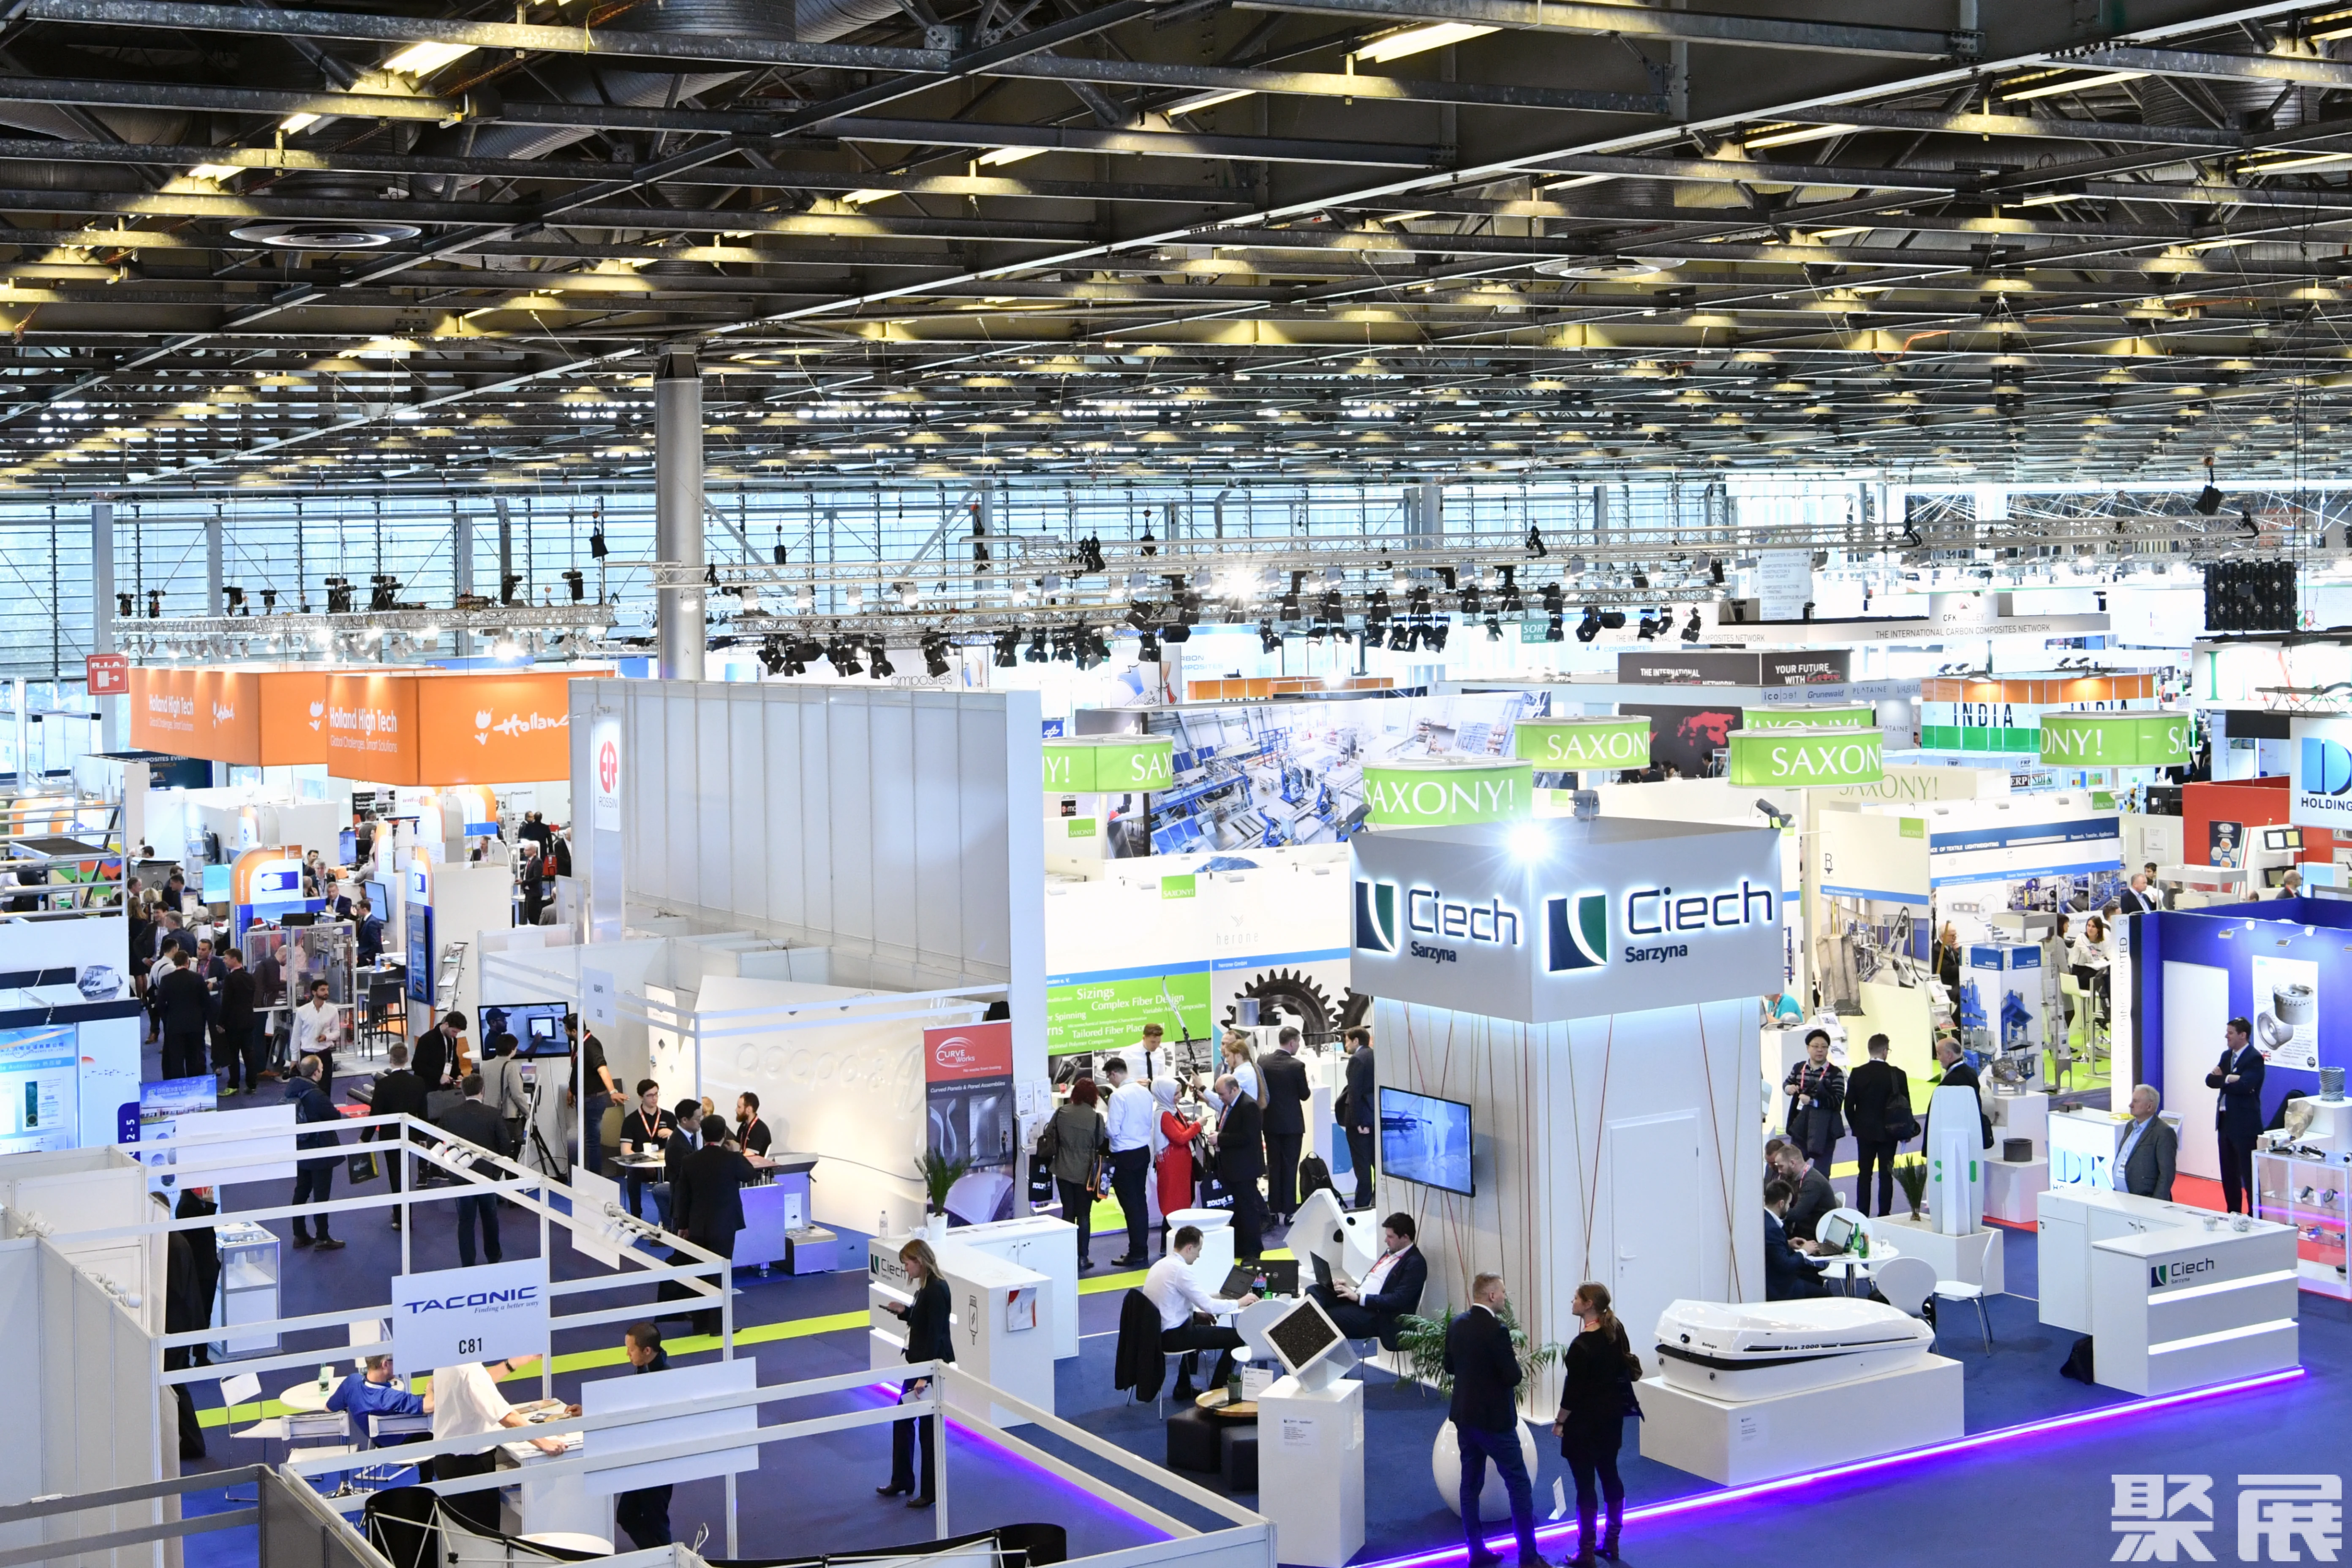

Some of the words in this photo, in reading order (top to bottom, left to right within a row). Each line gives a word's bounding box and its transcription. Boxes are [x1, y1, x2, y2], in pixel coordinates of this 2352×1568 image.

[1876, 631, 1889, 639] THE
[1890, 628, 1944, 638] INTERNATIONAL
[1946, 627, 1974, 635] CARBON
[1975, 625, 2017, 634] COMPOSITES
[2018, 624, 2050, 632] NETWORK
[1775, 665, 1797, 674] YOUR
[1798, 663, 1829, 673] FUTURE
[1785, 675, 1805, 684] WITH
[1808, 689, 1844, 699] Grunewald
[1853, 686, 1887, 694] PLATAINE
[149, 694, 168, 713] Holland
[169, 696, 180, 718] High
[181, 697, 194, 715] Tech
[329, 707, 357, 729] Holland
[359, 708, 376, 736] High
[377, 709, 397, 732] Tech
[1954, 702, 2013, 727] INDIA
[1547, 731, 1650, 761] SAXON
[1131, 753, 1173, 781] SAX
[1772, 743, 1883, 776] SAXON
[1043, 756, 1070, 783] Y!
[599, 796, 618, 809] ROSSINI
[1965, 842, 1999, 850] LIGHTWEIGHTING
[1162, 888, 1194, 898] SAXONY!
[1629, 880, 1773, 936] Ciech
[1408, 889, 1518, 945] Ciech
[1217, 932, 1258, 945] herone
[1411, 941, 1456, 963] Sarzyna
[1625, 942, 1688, 963] Sarzyna
[593, 983, 603, 993] ADAPA
[1077, 986, 1115, 1001] Sizings
[1091, 998, 1130, 1012] Complex
[1132, 996, 1153, 1006] Fiber
[1178, 1002, 1206, 1011] Composites
[1055, 1011, 1086, 1023] Spinning
[1047, 1026, 1064, 1036] rns
[1072, 1027, 1103, 1039] Tailored
[1105, 1025, 1124, 1035] Fiber
[936, 1049, 965, 1062] CURVE
[8, 1062, 40, 1070] Autoclave
[881, 1258, 906, 1279] Ciech
[2171, 1258, 2214, 1277] Ciech
[402, 1285, 538, 1314] TACONIC
[459, 1337, 482, 1354] C81
